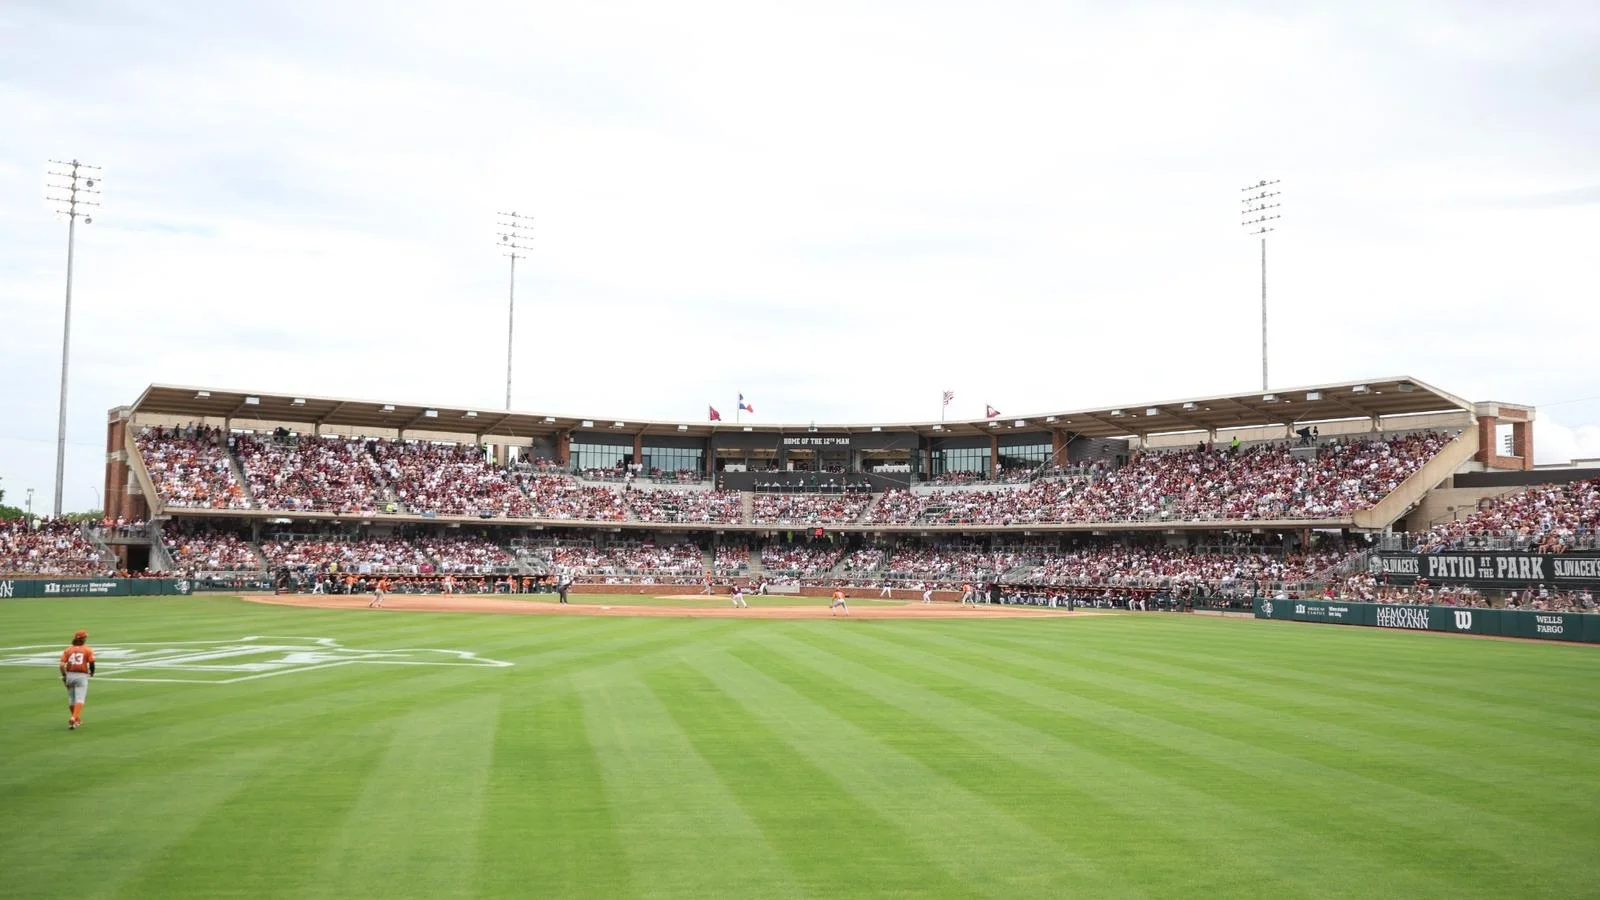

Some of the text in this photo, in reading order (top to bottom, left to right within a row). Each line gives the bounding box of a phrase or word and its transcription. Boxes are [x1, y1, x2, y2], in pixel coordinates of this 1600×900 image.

[783, 437, 800, 445] HOME
[801, 437, 809, 445] OF
[810, 437, 822, 445] THE
[836, 437, 850, 445] MAN
[1383, 558, 1419, 574] SLOVACEK'S
[1428, 556, 1545, 579] PATIO AT THE PARK
[1377, 607, 1429, 619] MEMORIAL
[1377, 616, 1428, 629] HERMANN
[1536, 615, 1563, 624] WELLS
[1537, 625, 1563, 633] FARGO
[69, 652, 84, 665] 43
